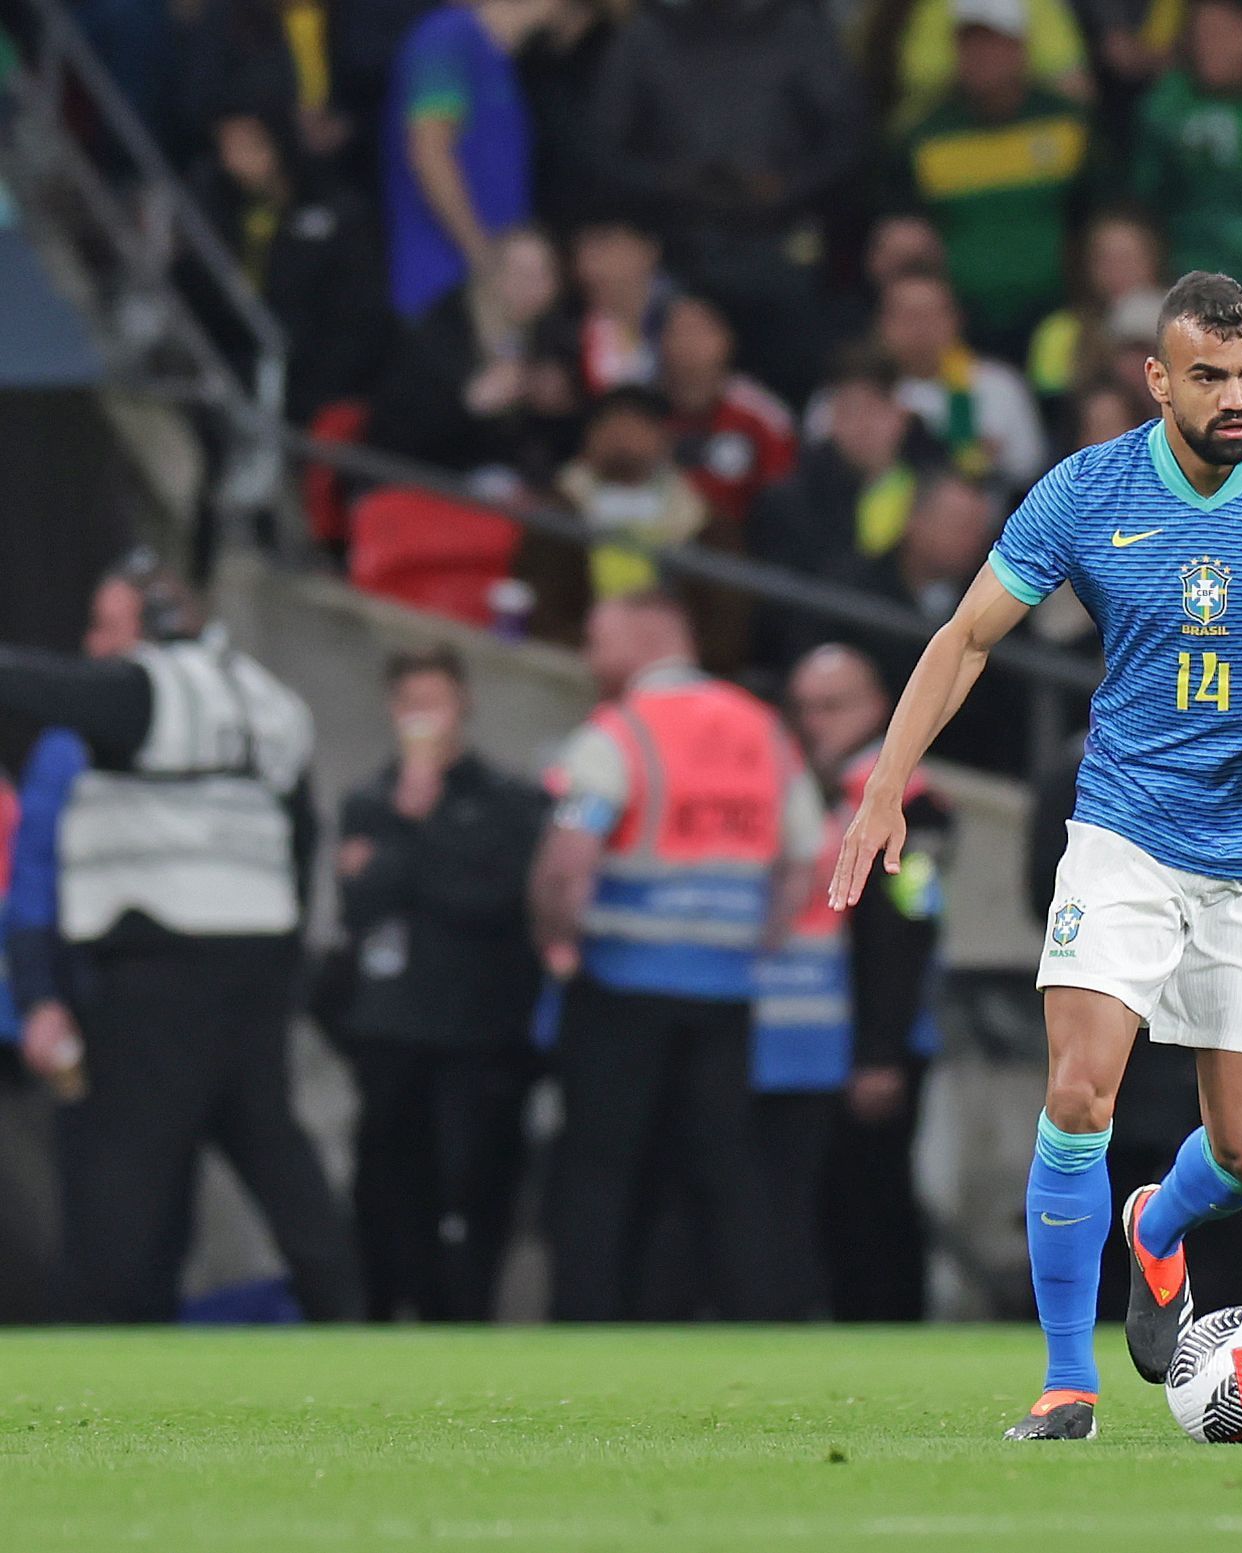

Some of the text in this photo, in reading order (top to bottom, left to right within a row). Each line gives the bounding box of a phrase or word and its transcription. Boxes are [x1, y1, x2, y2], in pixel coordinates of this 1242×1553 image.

[1196, 589, 1214, 597] CBF
[1182, 625, 1229, 635] BRASIL
[1177, 652, 1230, 711] 14
